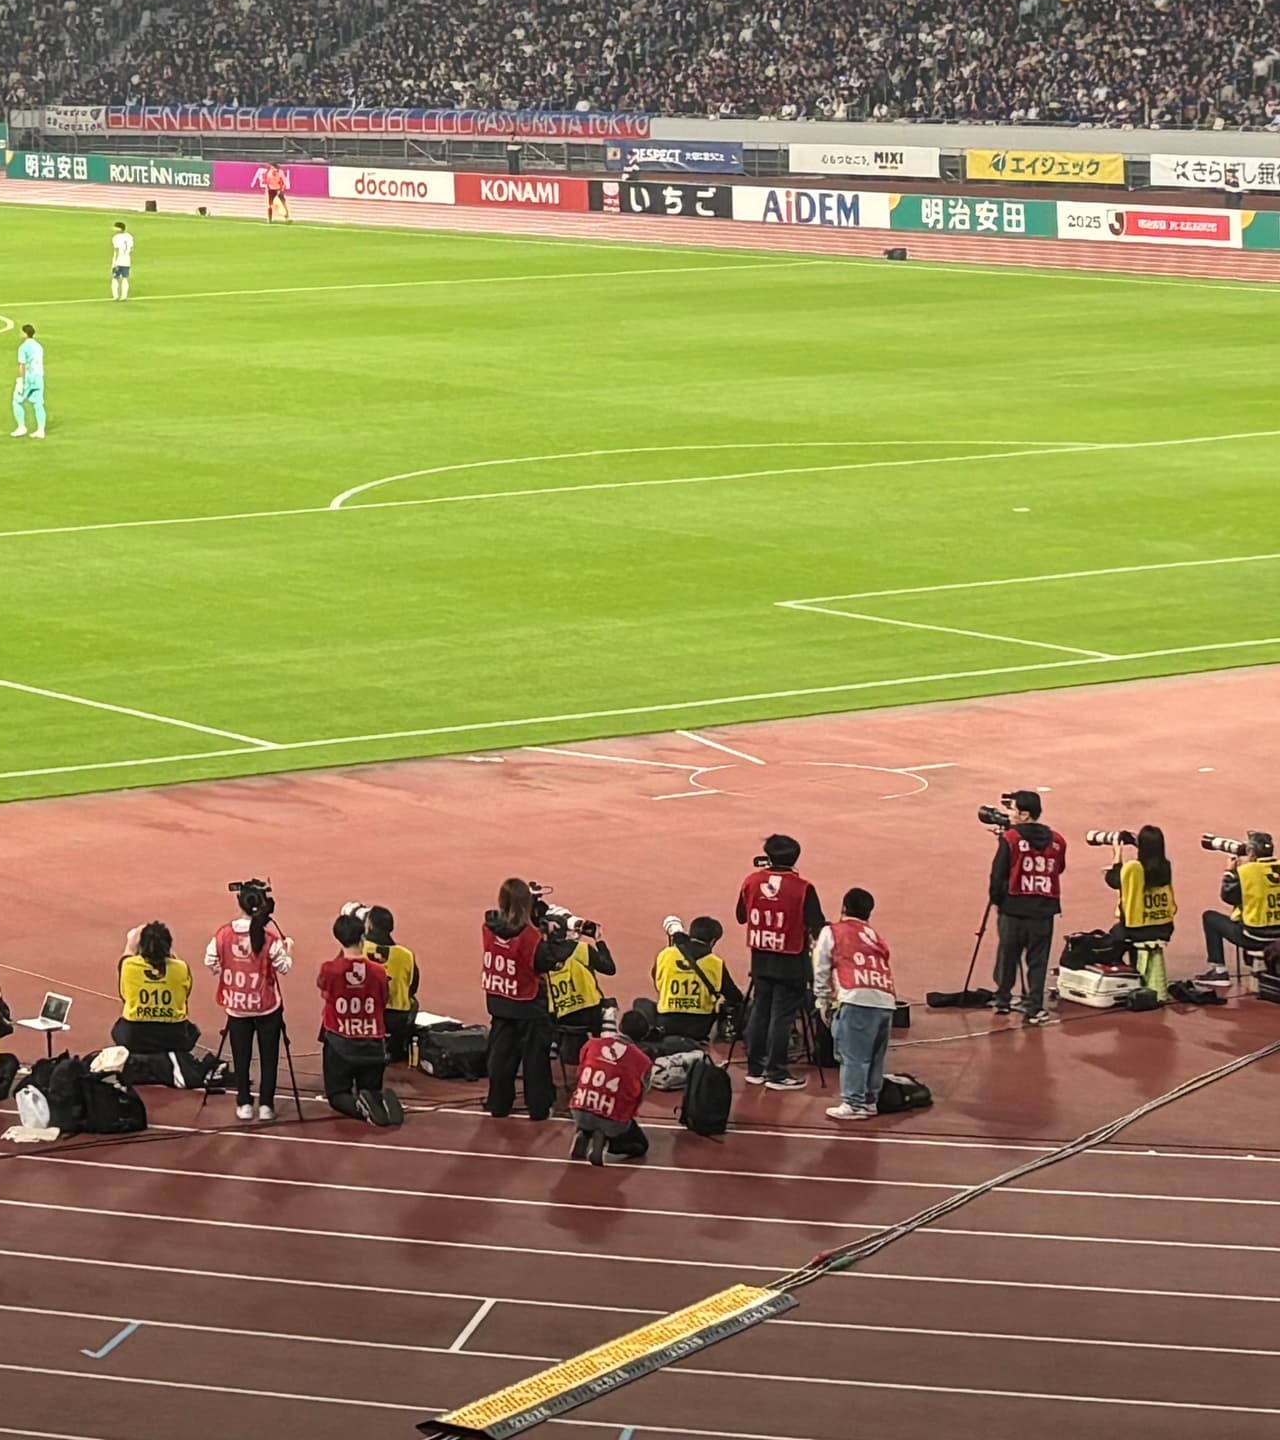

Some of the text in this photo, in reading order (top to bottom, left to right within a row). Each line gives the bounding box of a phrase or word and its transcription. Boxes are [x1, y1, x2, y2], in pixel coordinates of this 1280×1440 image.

[25, 154, 87, 180] 明治安田
[874, 151, 904, 165] MIXI
[1011, 157, 1100, 176] エイジェック
[110, 164, 149, 184] ROUTE
[174, 173, 210, 187] HOTELS
[355, 173, 428, 198] docomo
[481, 178, 560, 204] KONAMI
[630, 186, 717, 217] いちご
[763, 190, 861, 226] AiDEM
[921, 197, 1026, 232] 明治安田
[1067, 214, 1102, 229] 2025
[1144, 893, 1169, 909] 009
[751, 909, 785, 929] 011
[750, 930, 785, 951] NRH
[484, 952, 516, 975] 005
[223, 969, 259, 989] 007
[481, 972, 517, 995] NRH
[670, 980, 701, 996] 012
[140, 989, 172, 1005] 010
[222, 990, 261, 1009] NRH
[336, 997, 374, 1015] 006
[668, 998, 701, 1009] PRESS
[137, 1007, 174, 1018] PRESS
[580, 1067, 621, 1092] 004
[575, 1090, 616, 1116] NRH
